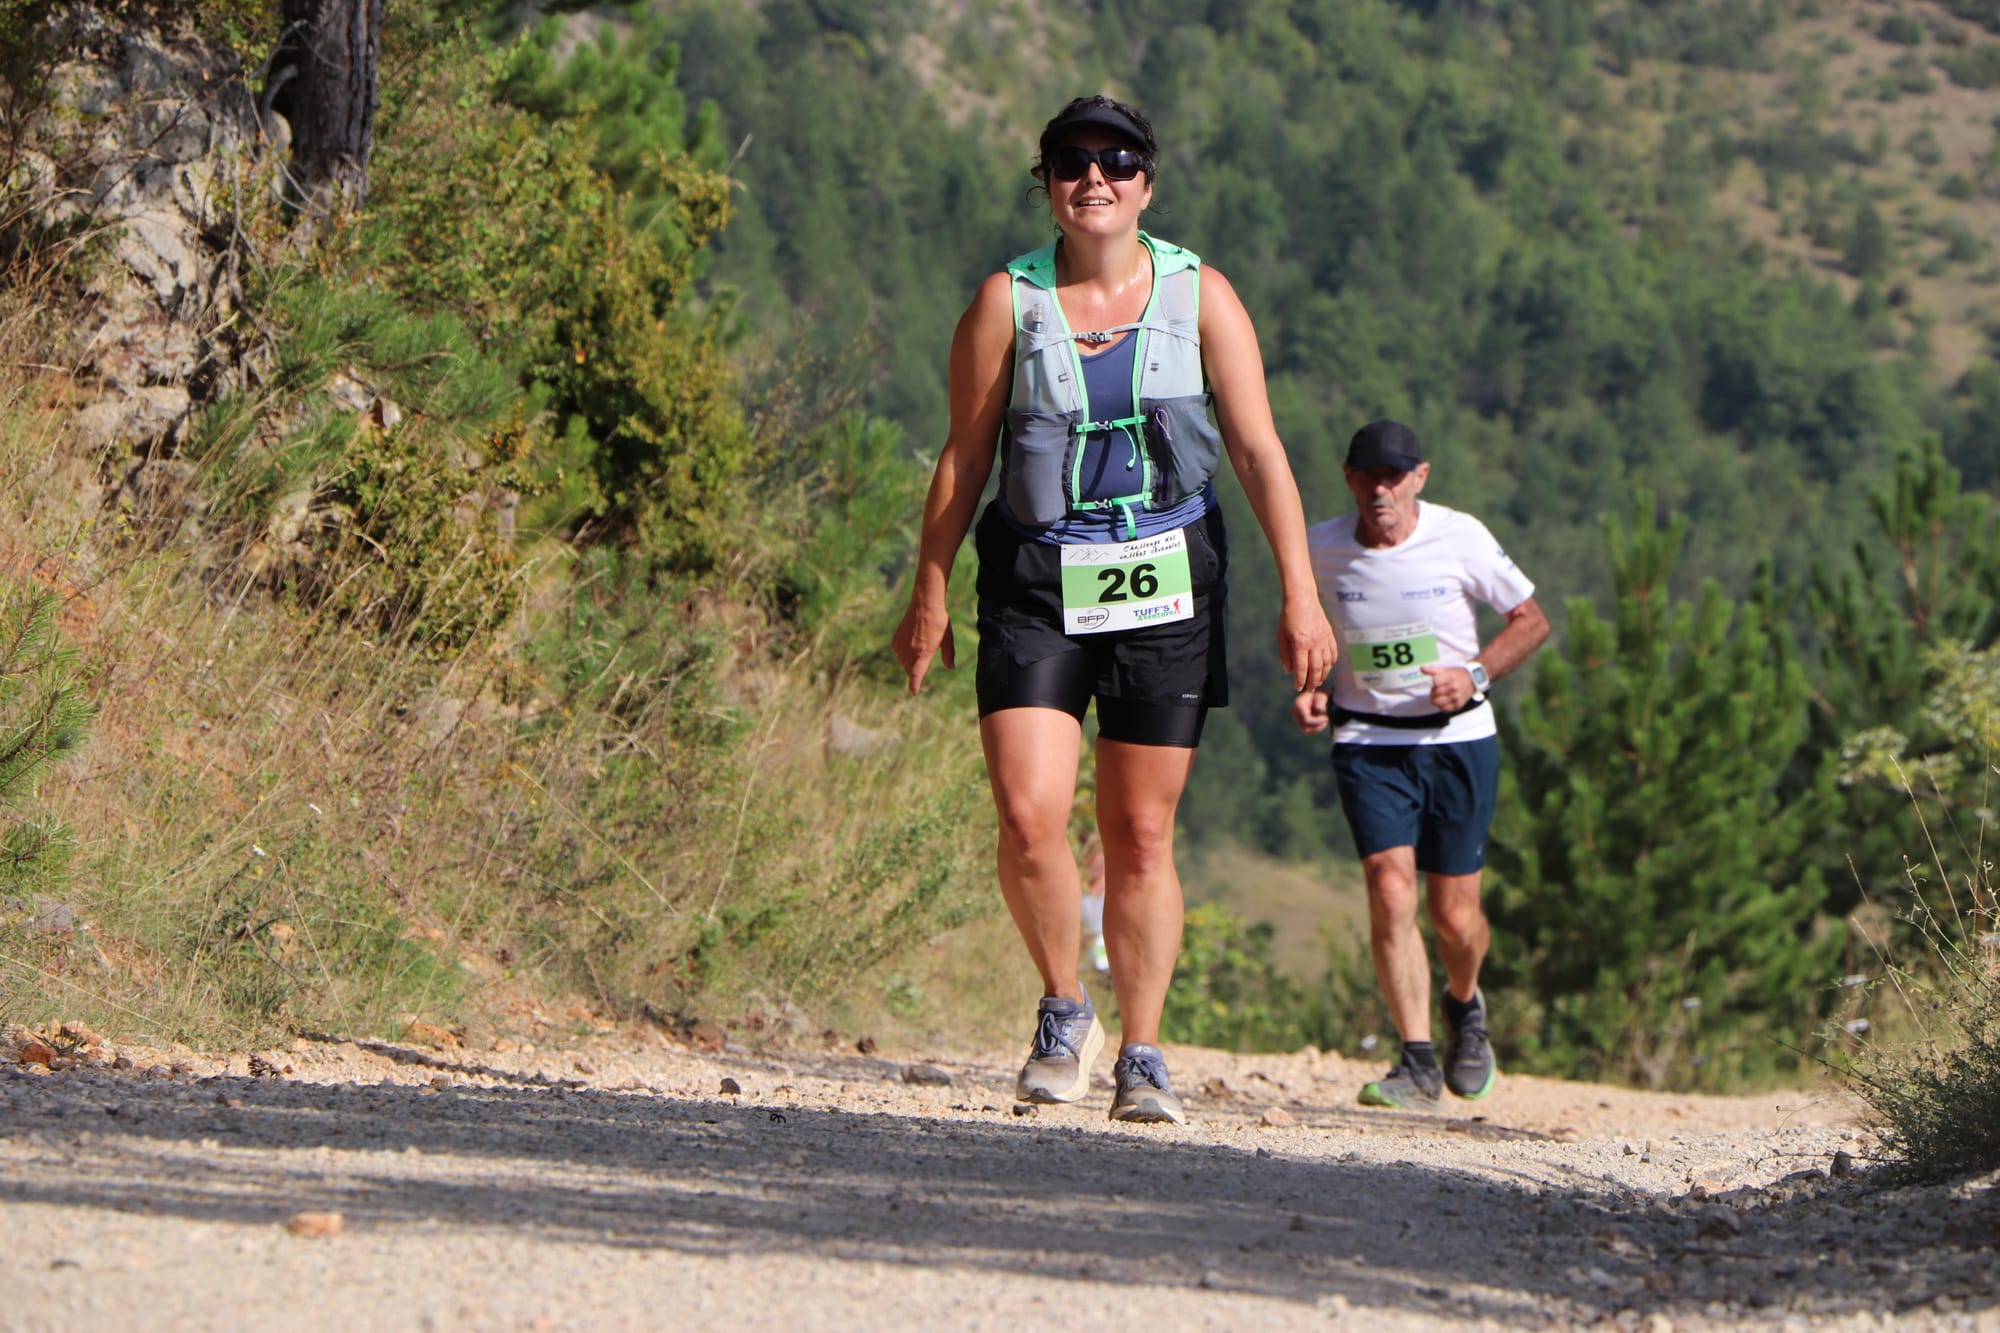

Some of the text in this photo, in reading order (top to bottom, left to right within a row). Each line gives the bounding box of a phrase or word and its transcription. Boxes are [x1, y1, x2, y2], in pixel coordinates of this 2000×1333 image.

[1123, 540, 1161, 552] Challenge
[1097, 563, 1159, 603] 26
[1132, 604, 1169, 617] TUFF'S
[1077, 614, 1105, 624] BFP
[1372, 642, 1414, 669] 58
